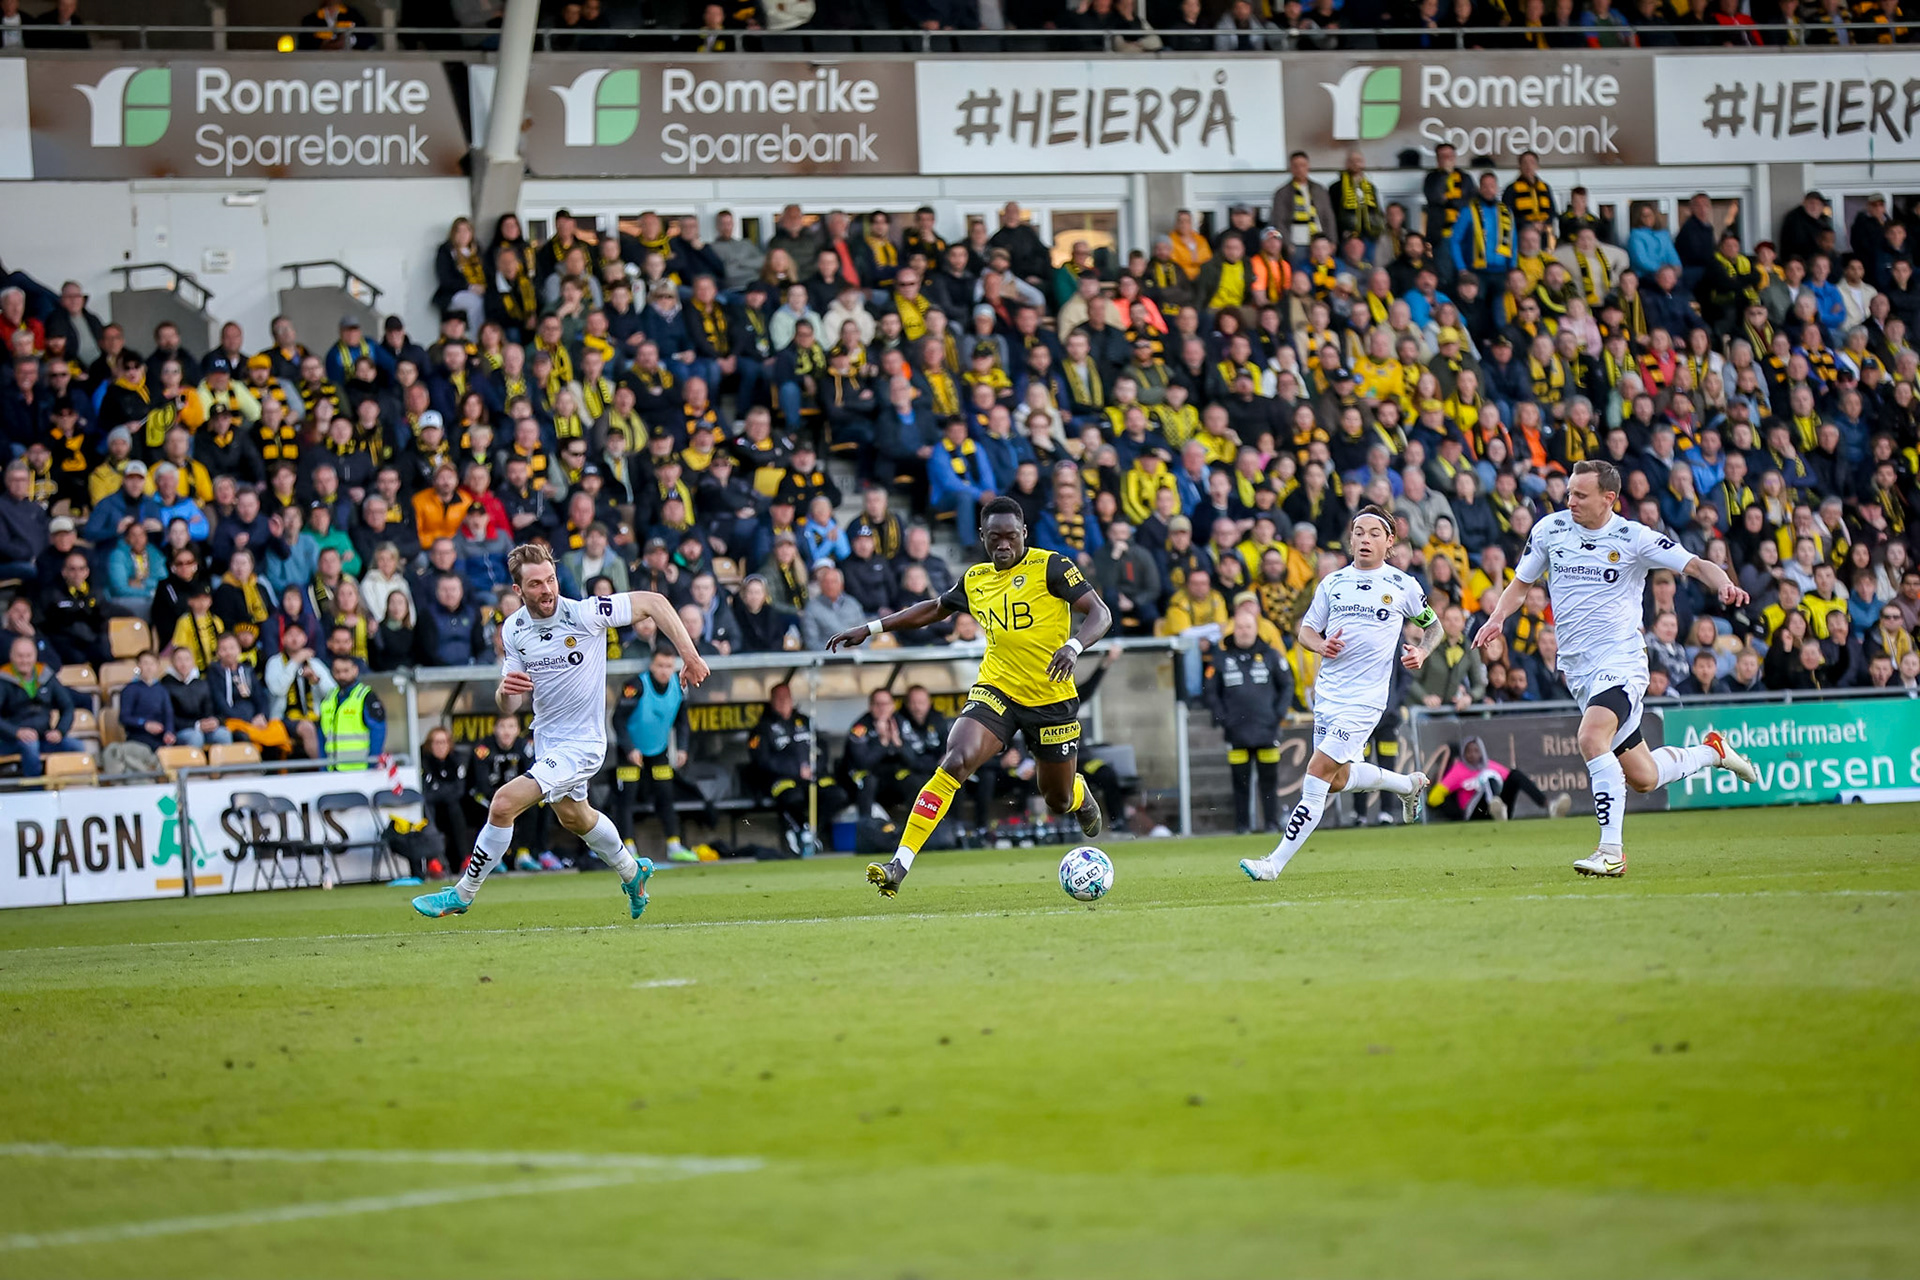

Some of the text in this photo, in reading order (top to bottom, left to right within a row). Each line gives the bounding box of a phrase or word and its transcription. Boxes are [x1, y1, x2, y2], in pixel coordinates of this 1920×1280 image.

[196, 67, 430, 114] Romerike
[662, 68, 879, 113] Romerike
[1420, 63, 1620, 108] Romerike
[955, 69, 1238, 155] #HEIERPÅ
[195, 124, 430, 177] Sparebank
[661, 122, 879, 174] Sparebank
[1419, 115, 1620, 157] Sparebank
[1553, 563, 1602, 576] SpareBank
[1285, 804, 1312, 841] coop
[17, 813, 144, 878] RAGN
[1074, 865, 1101, 887] SELECT
